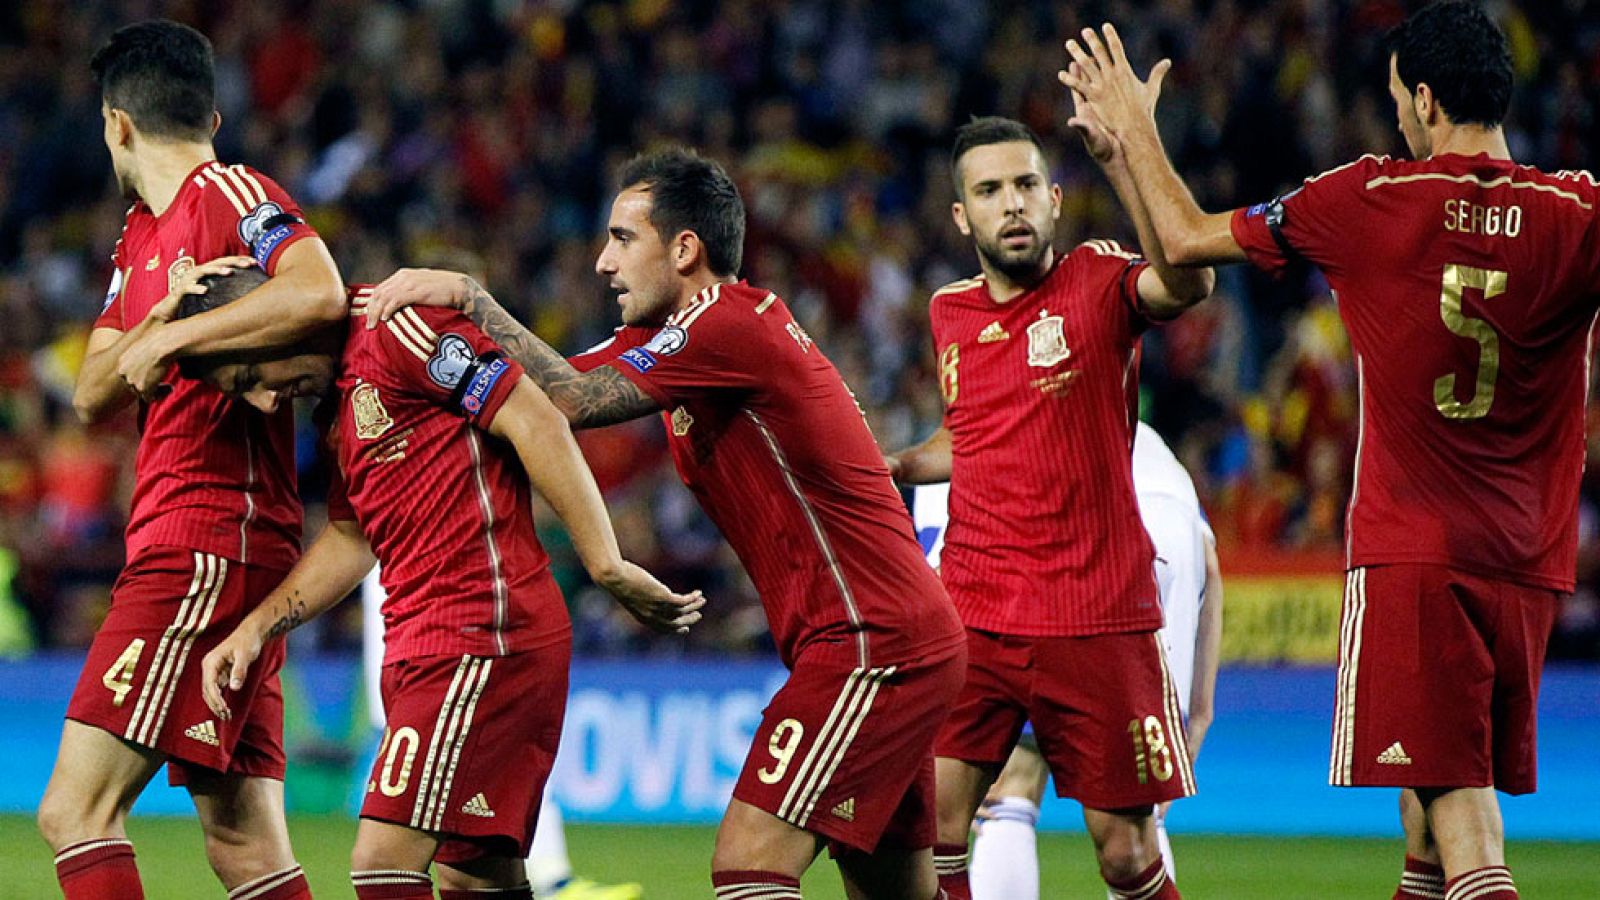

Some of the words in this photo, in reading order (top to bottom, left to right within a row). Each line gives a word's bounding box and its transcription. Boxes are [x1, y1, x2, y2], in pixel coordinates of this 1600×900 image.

[1444, 199, 1522, 237] SERGIO
[1433, 263, 1508, 418] 5
[472, 359, 504, 398] RESPECT
[102, 638, 146, 707] 4
[757, 718, 804, 785] 9
[1127, 714, 1174, 784] 18
